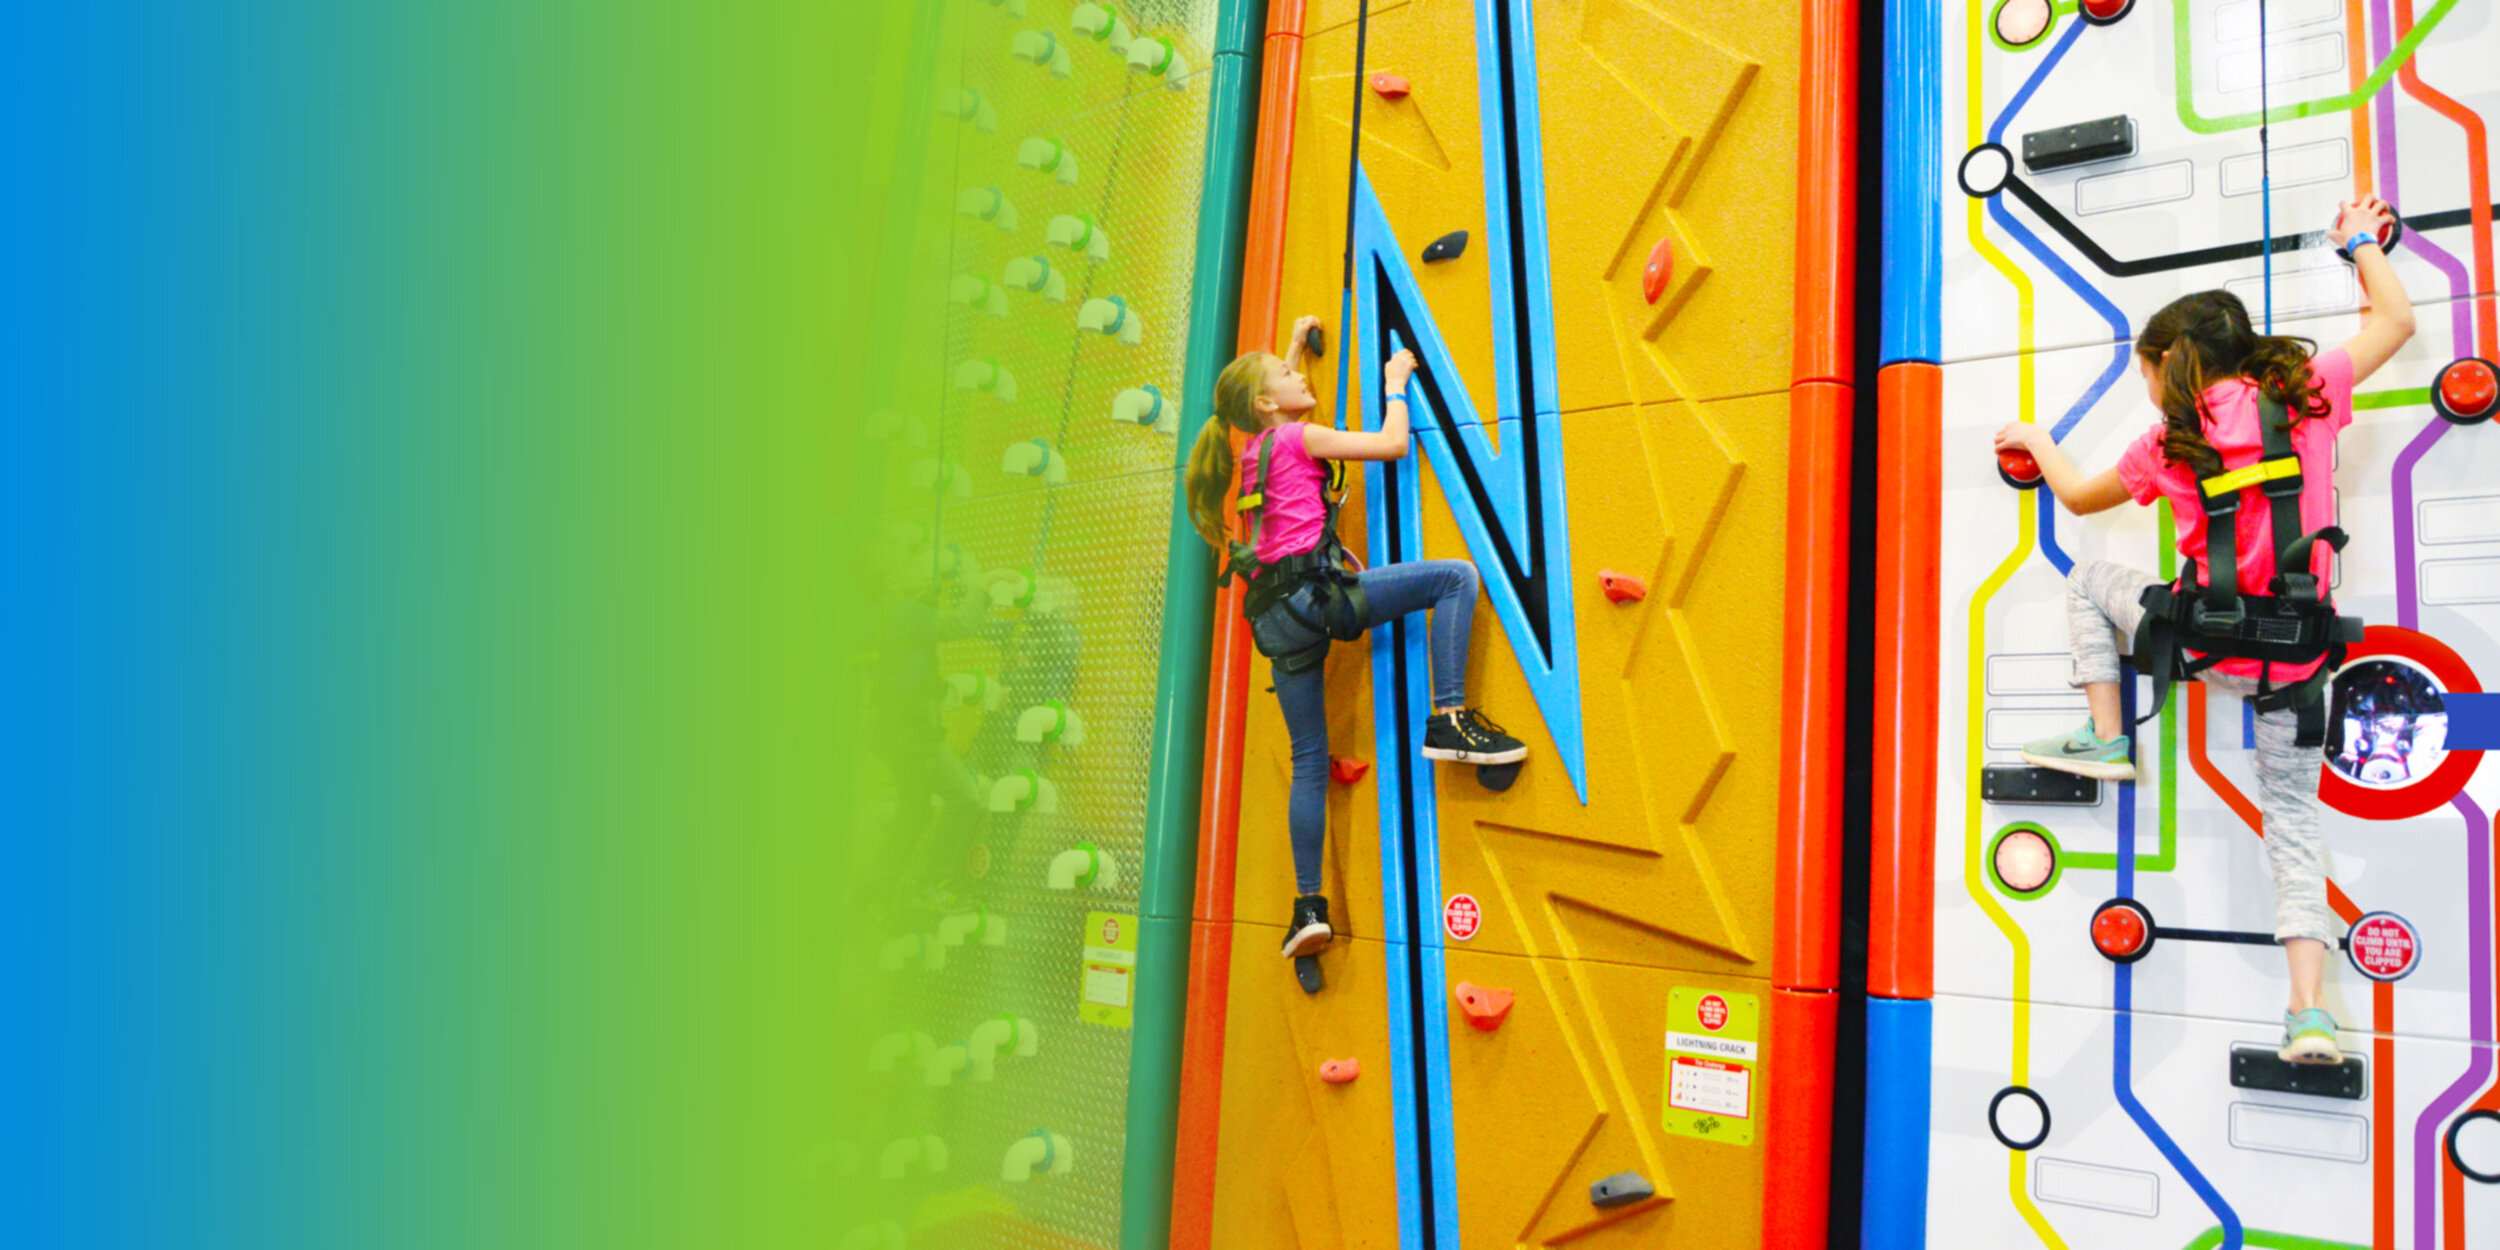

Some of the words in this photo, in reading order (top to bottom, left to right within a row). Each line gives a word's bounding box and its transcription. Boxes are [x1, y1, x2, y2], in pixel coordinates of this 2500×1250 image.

[2367, 926, 2380, 936] DO
[2382, 928, 2399, 937] NOT
[2356, 936, 2383, 945] CLIMB
[2385, 938, 2411, 949] UNTIL
[2365, 947, 2382, 956] YOU
[2384, 948, 2402, 957] ARE
[2364, 956, 2402, 967] CLIPPED
[1676, 1037, 1718, 1051] LIGHTNING
[1719, 1042, 1746, 1054] CRACK
